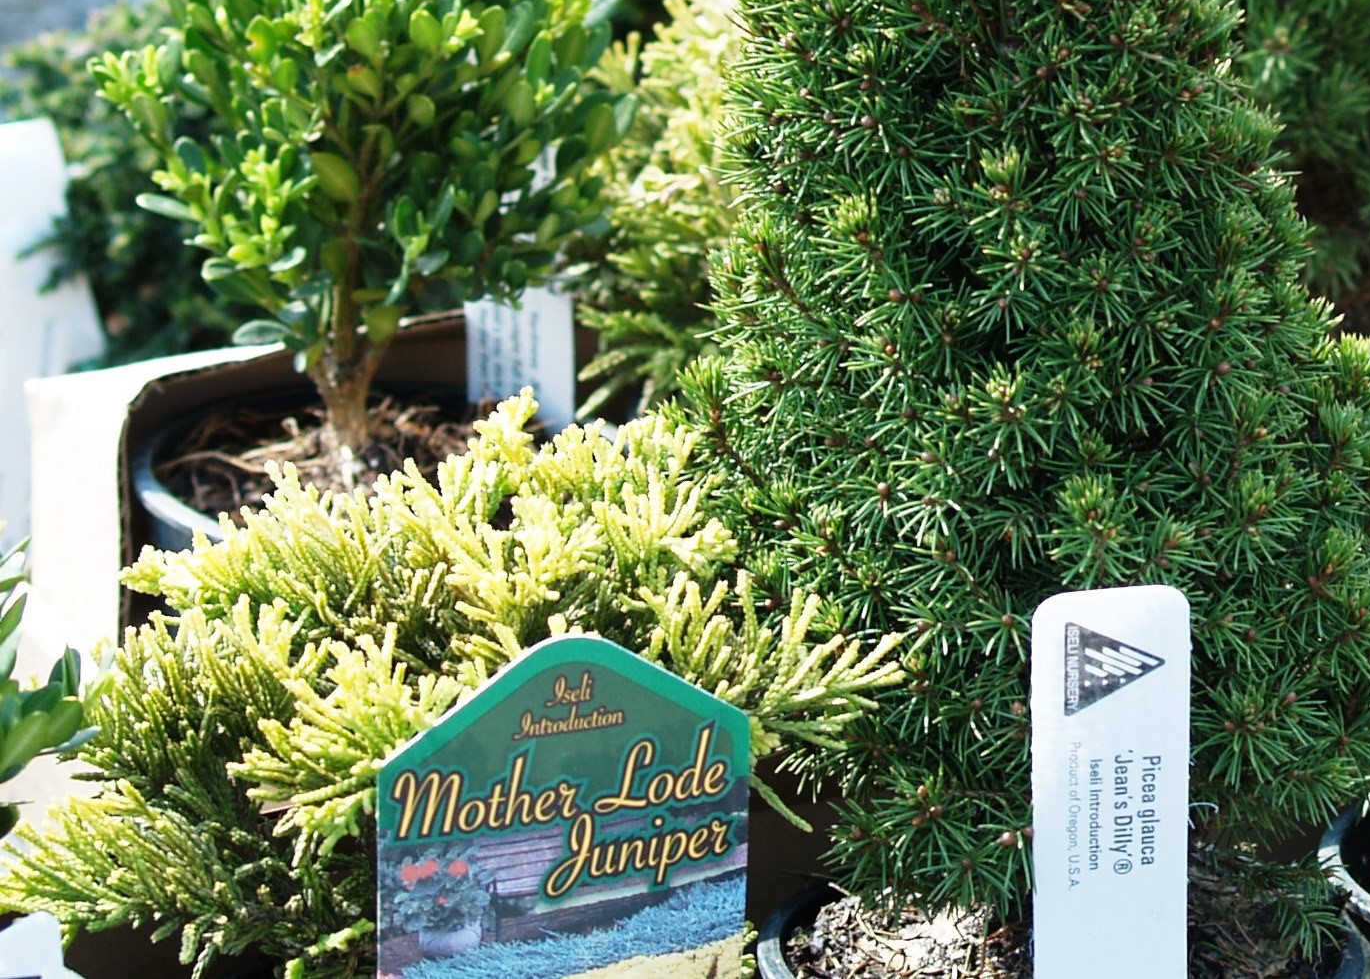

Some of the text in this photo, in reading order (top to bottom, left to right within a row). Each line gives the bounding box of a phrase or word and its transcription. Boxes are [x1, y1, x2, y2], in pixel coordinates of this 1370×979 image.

[545, 671, 592, 708] Iseli
[1066, 625, 1080, 711] ISELI NURSERY
[512, 705, 624, 740] Introduction
[1069, 741, 1081, 786] Product
[392, 726, 727, 839] Mother Lode
[1069, 789, 1081, 801] of
[1089, 759, 1103, 871] Iseli Introduction
[1138, 755, 1161, 866] Picea glauca
[545, 814, 728, 898] Juniper
